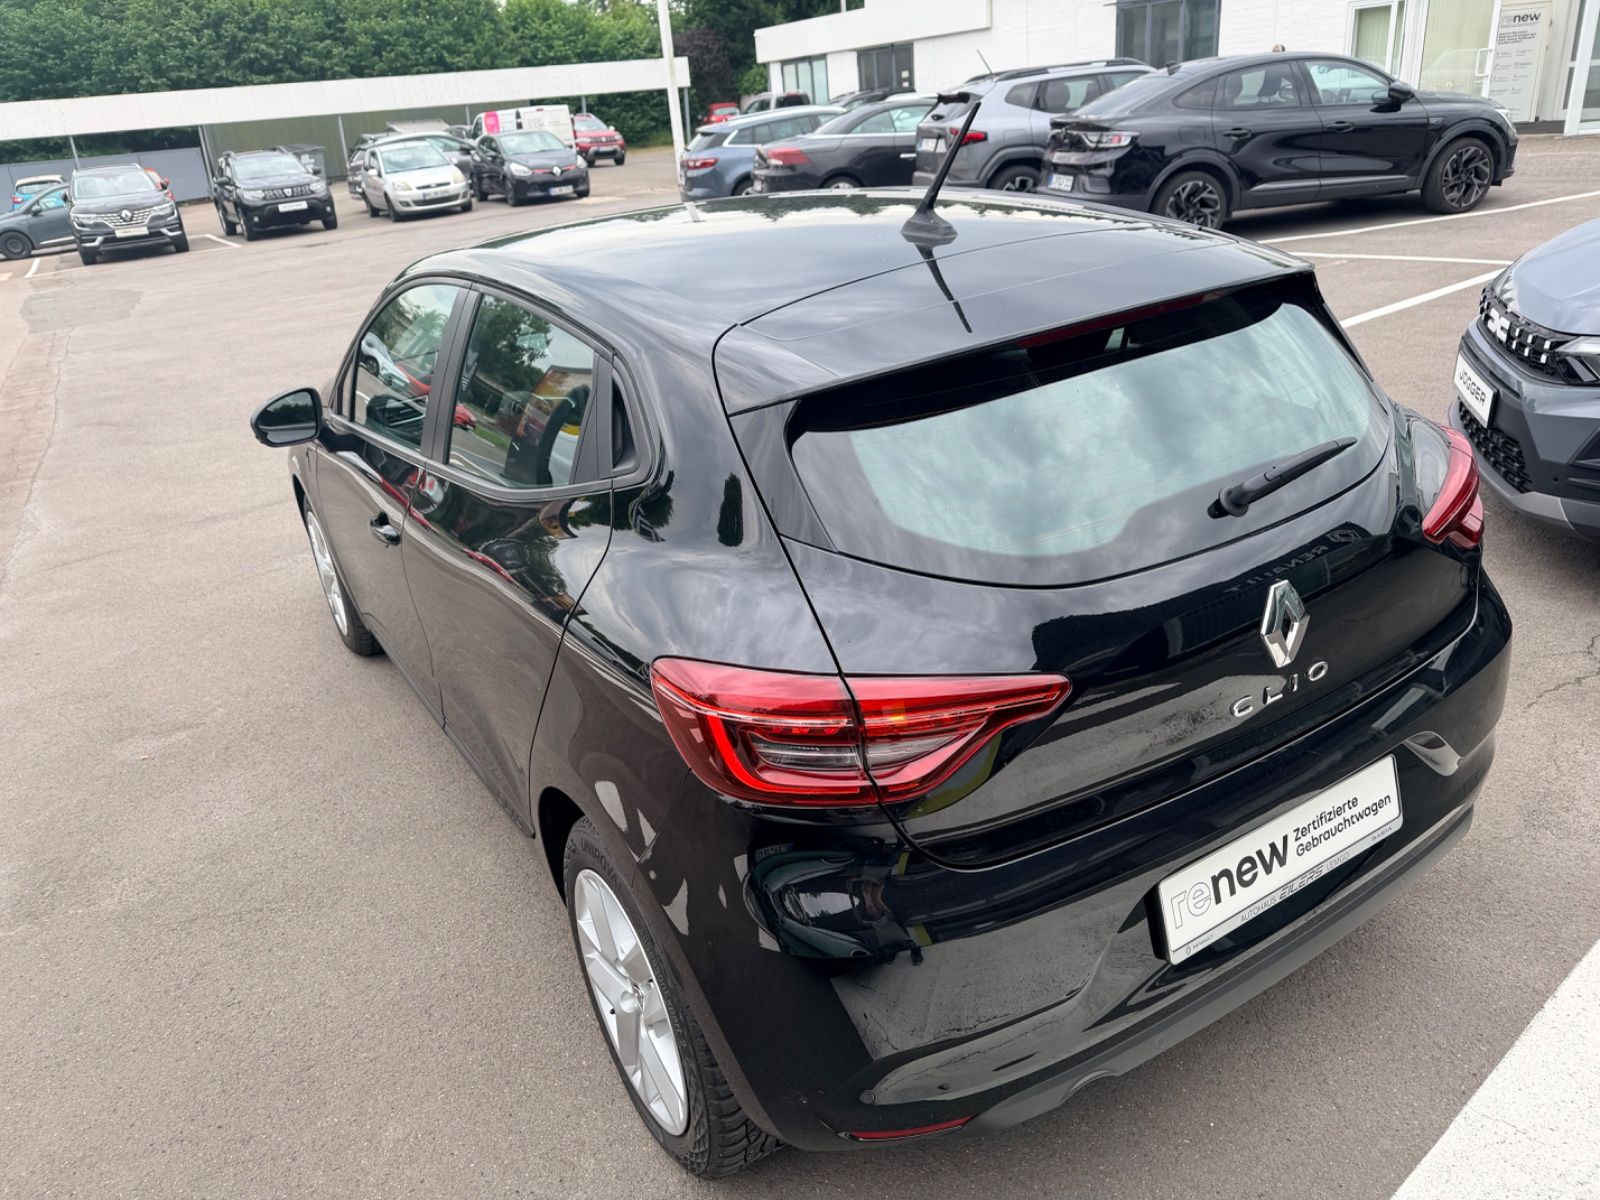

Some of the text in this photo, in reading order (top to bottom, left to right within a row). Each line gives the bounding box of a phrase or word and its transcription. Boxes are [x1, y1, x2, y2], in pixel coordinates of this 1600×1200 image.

[1459, 369, 1487, 407] JOGGER
[1231, 660, 1329, 718] CLIO
[1293, 796, 1359, 842] Zertifizierte
[1296, 794, 1392, 857] Gebrauchtwagen
[1170, 834, 1289, 930] renew
[1240, 852, 1350, 923] AUTOHAUS EILERS LEMGO
